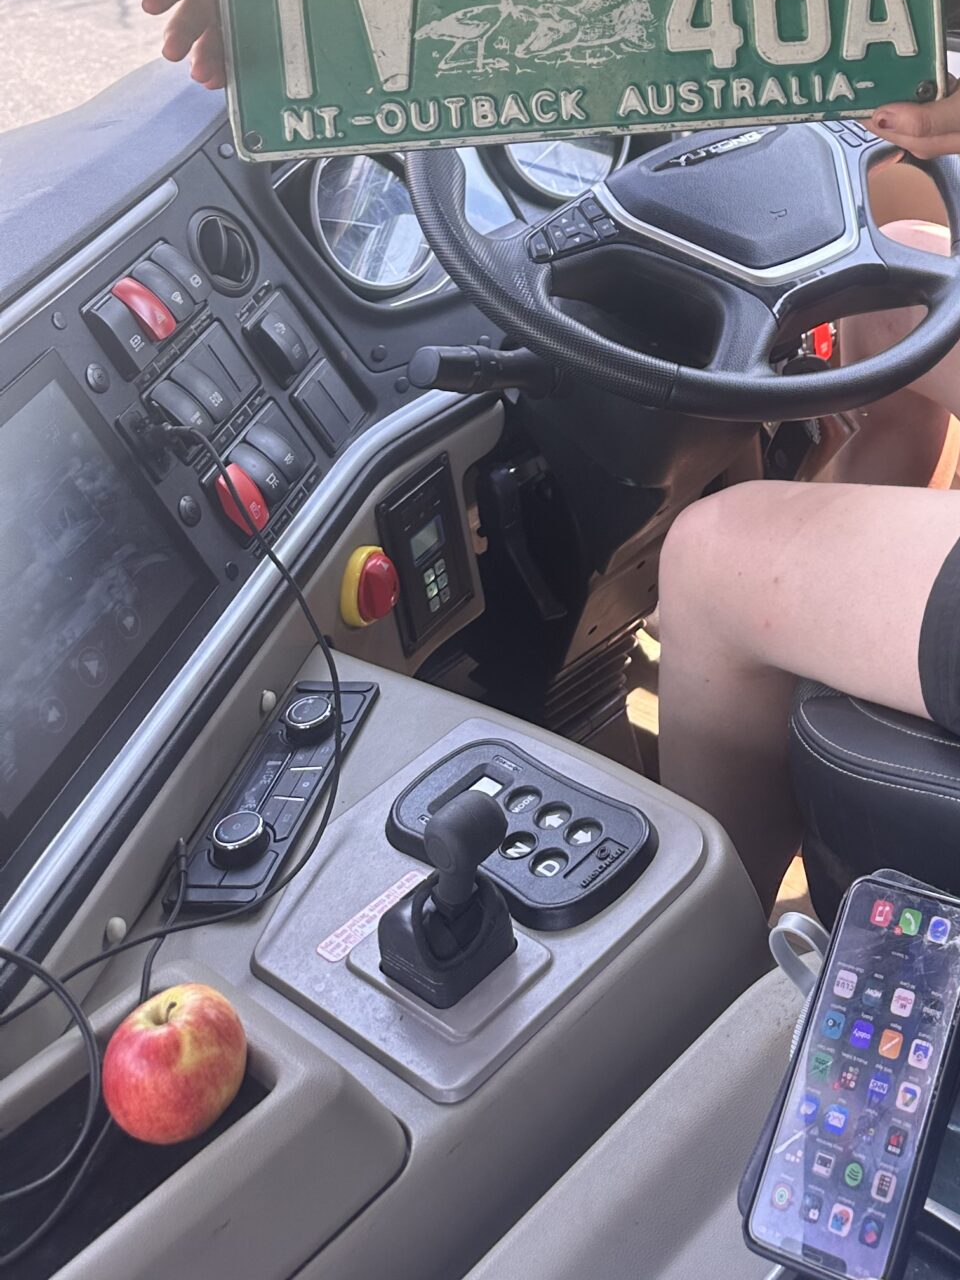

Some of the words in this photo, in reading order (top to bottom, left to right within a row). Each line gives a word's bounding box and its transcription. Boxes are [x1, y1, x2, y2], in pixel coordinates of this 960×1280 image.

[511, 793, 537, 813] MODE
[505, 841, 532, 858] N
[536, 859, 561, 877] D
